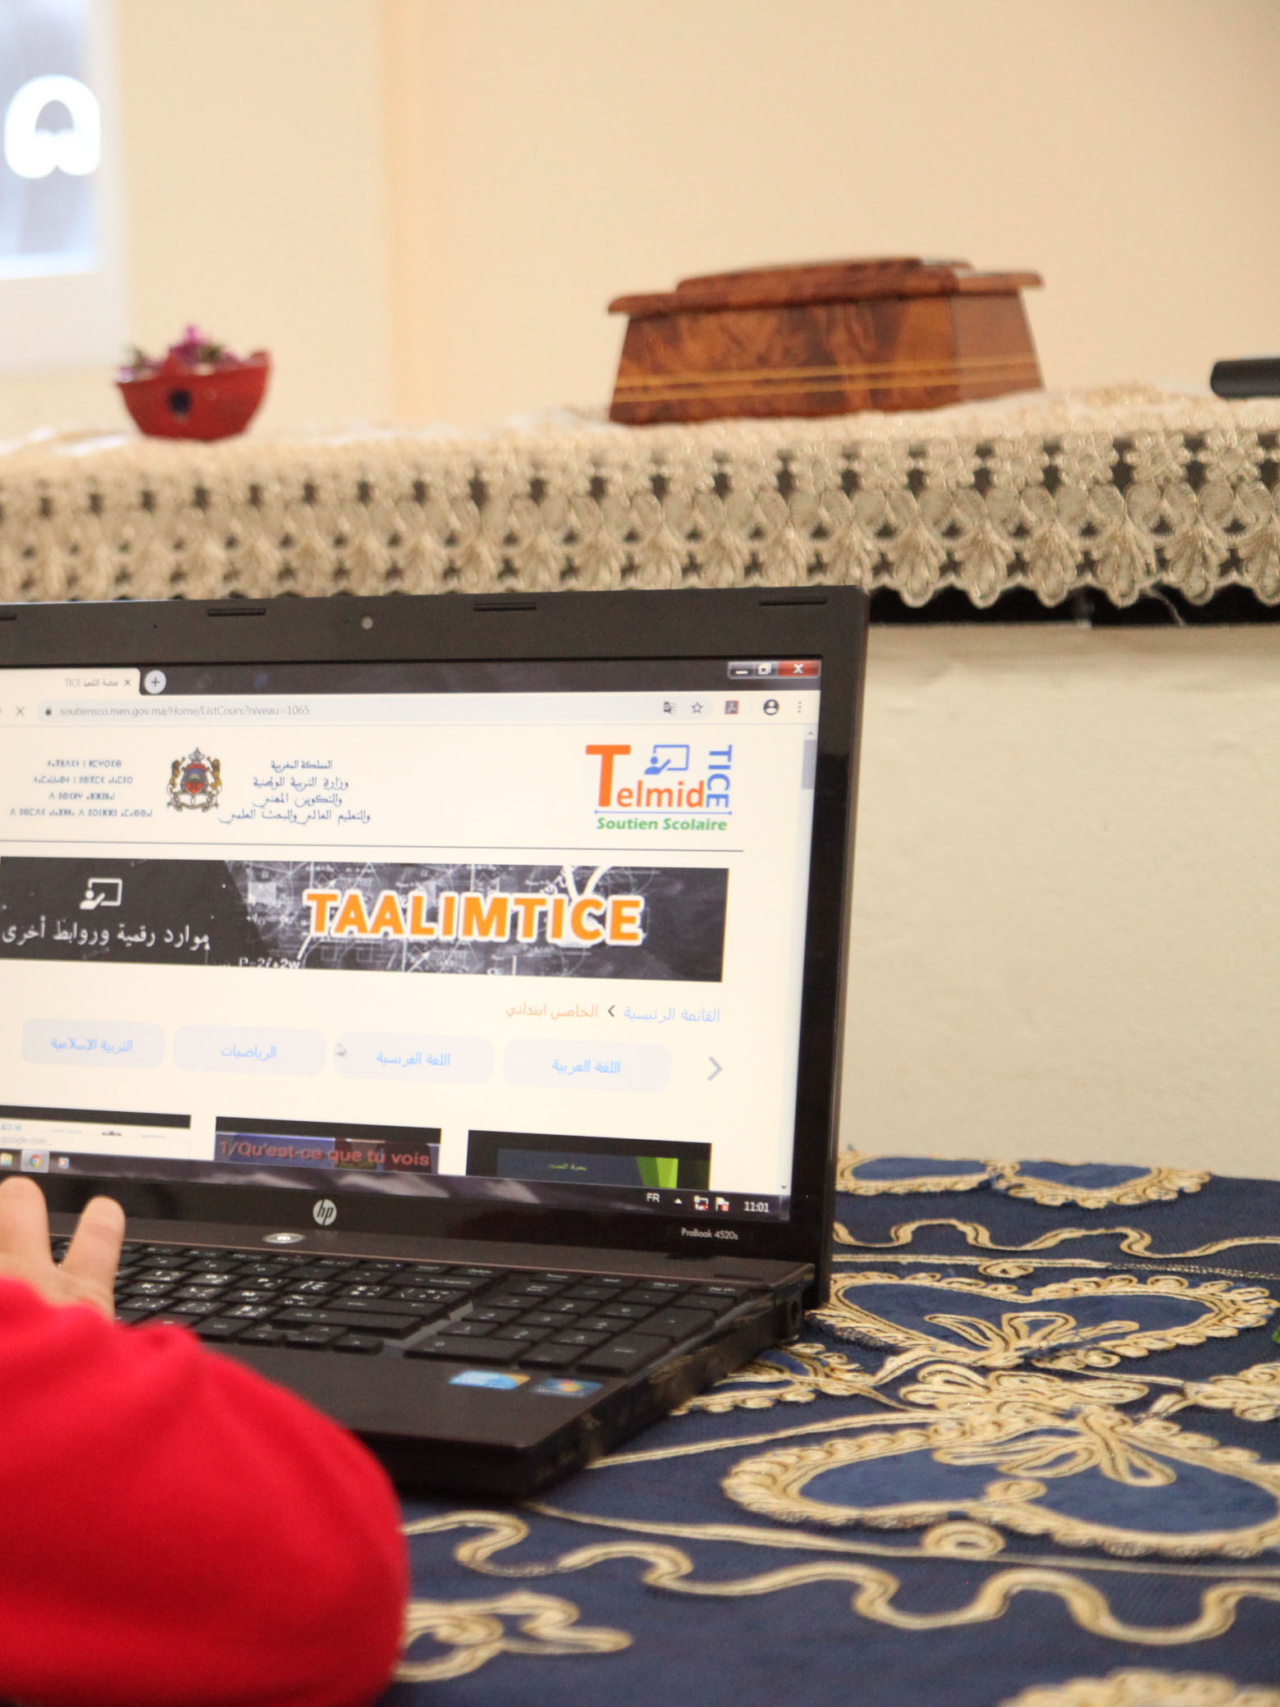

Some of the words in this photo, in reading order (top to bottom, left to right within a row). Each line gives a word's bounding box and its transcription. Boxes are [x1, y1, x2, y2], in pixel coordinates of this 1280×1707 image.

[270, 760, 299, 773] المغربية
[301, 760, 333, 770] المملكة
[253, 776, 285, 791] الوطنية
[585, 744, 705, 808] Telmid
[706, 744, 732, 808] TICE
[290, 777, 317, 791] التربية
[323, 777, 349, 791] وزارة
[597, 817, 658, 830] Soutien
[663, 818, 728, 831] Scolaire
[304, 890, 644, 944] TAALIMTICE
[1, 915, 46, 947] أخرى
[53, 919, 110, 947] وروابط
[117, 923, 156, 948] رقمية
[164, 924, 210, 948] موارد
[551, 1004, 599, 1020] الخامس
[221, 1141, 324, 1161] 1/Qu'est-ce
[328, 1148, 363, 1163] que
[368, 1148, 386, 1164] tu
[391, 1151, 430, 1167] vois
[646, 1192, 660, 1203] FR
[743, 1201, 770, 1213] 11:01
[681, 1227, 712, 1239] ProBook
[714, 1230, 738, 1241] 4520s
